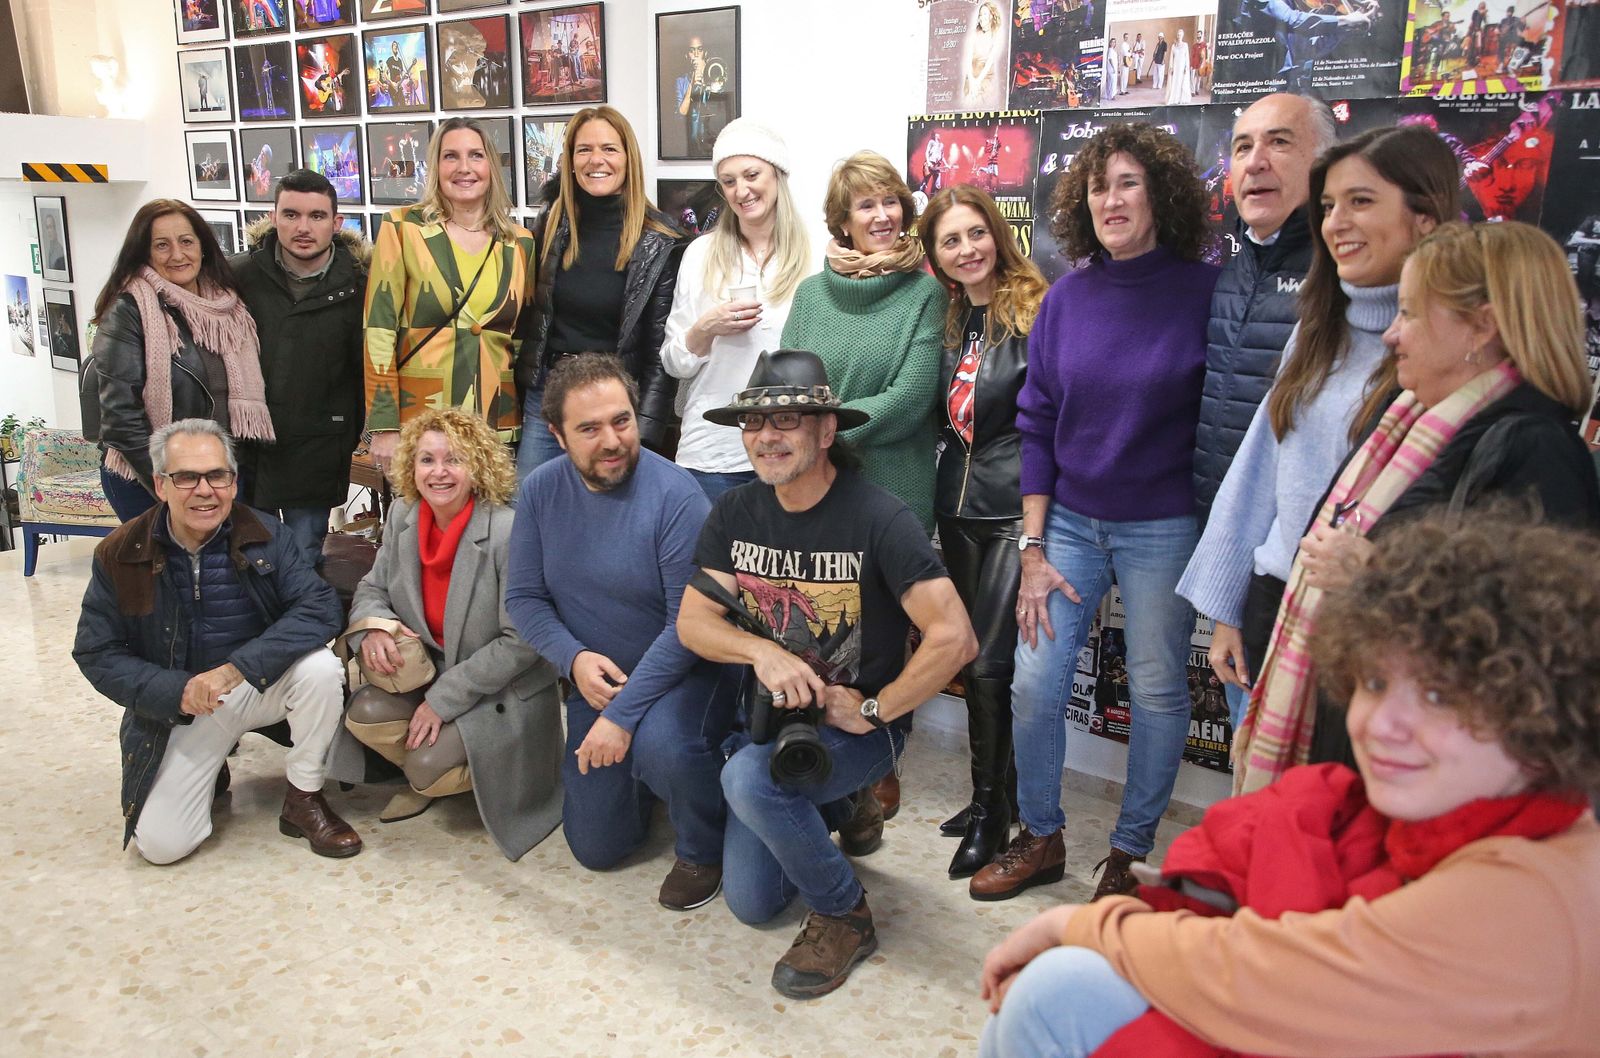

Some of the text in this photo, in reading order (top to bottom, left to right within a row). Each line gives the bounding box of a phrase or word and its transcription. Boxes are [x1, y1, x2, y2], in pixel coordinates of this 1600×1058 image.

[1222, 31, 1254, 40] ESTAÇÕES
[1217, 37, 1276, 46] VIVALDI/PIAZZOLA
[1244, 52, 1264, 60] Project
[994, 201, 1031, 218] RVANA
[730, 539, 864, 582] BRUTAL THIN
